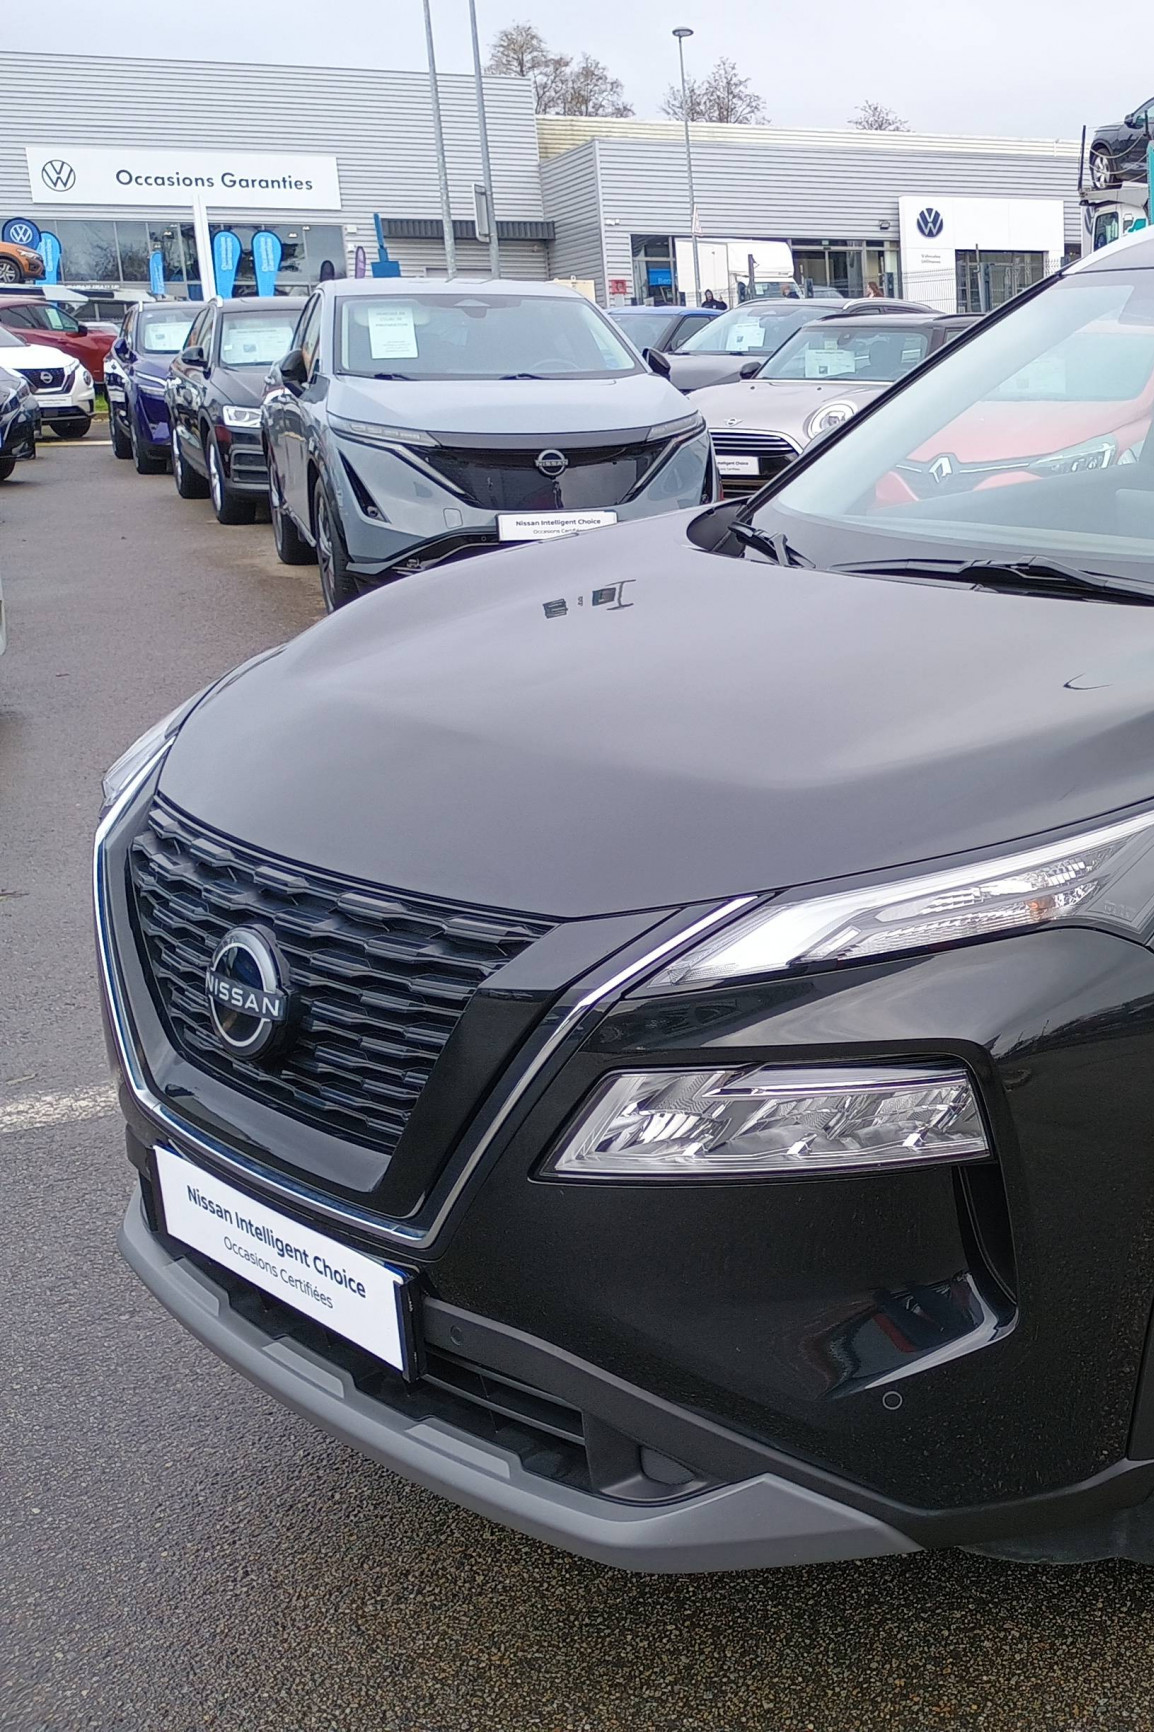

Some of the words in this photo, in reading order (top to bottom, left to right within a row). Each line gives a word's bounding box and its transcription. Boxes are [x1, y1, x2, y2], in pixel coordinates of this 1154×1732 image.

[115, 169, 215, 188] Occasions
[220, 172, 314, 190] Garanties
[205, 971, 280, 1017] NISSAN
[187, 1185, 233, 1225] Nissan
[235, 1212, 311, 1268] Intelligent
[313, 1255, 367, 1299] Choice
[223, 1236, 279, 1278] Occasions
[279, 1269, 334, 1309] Certifiées
